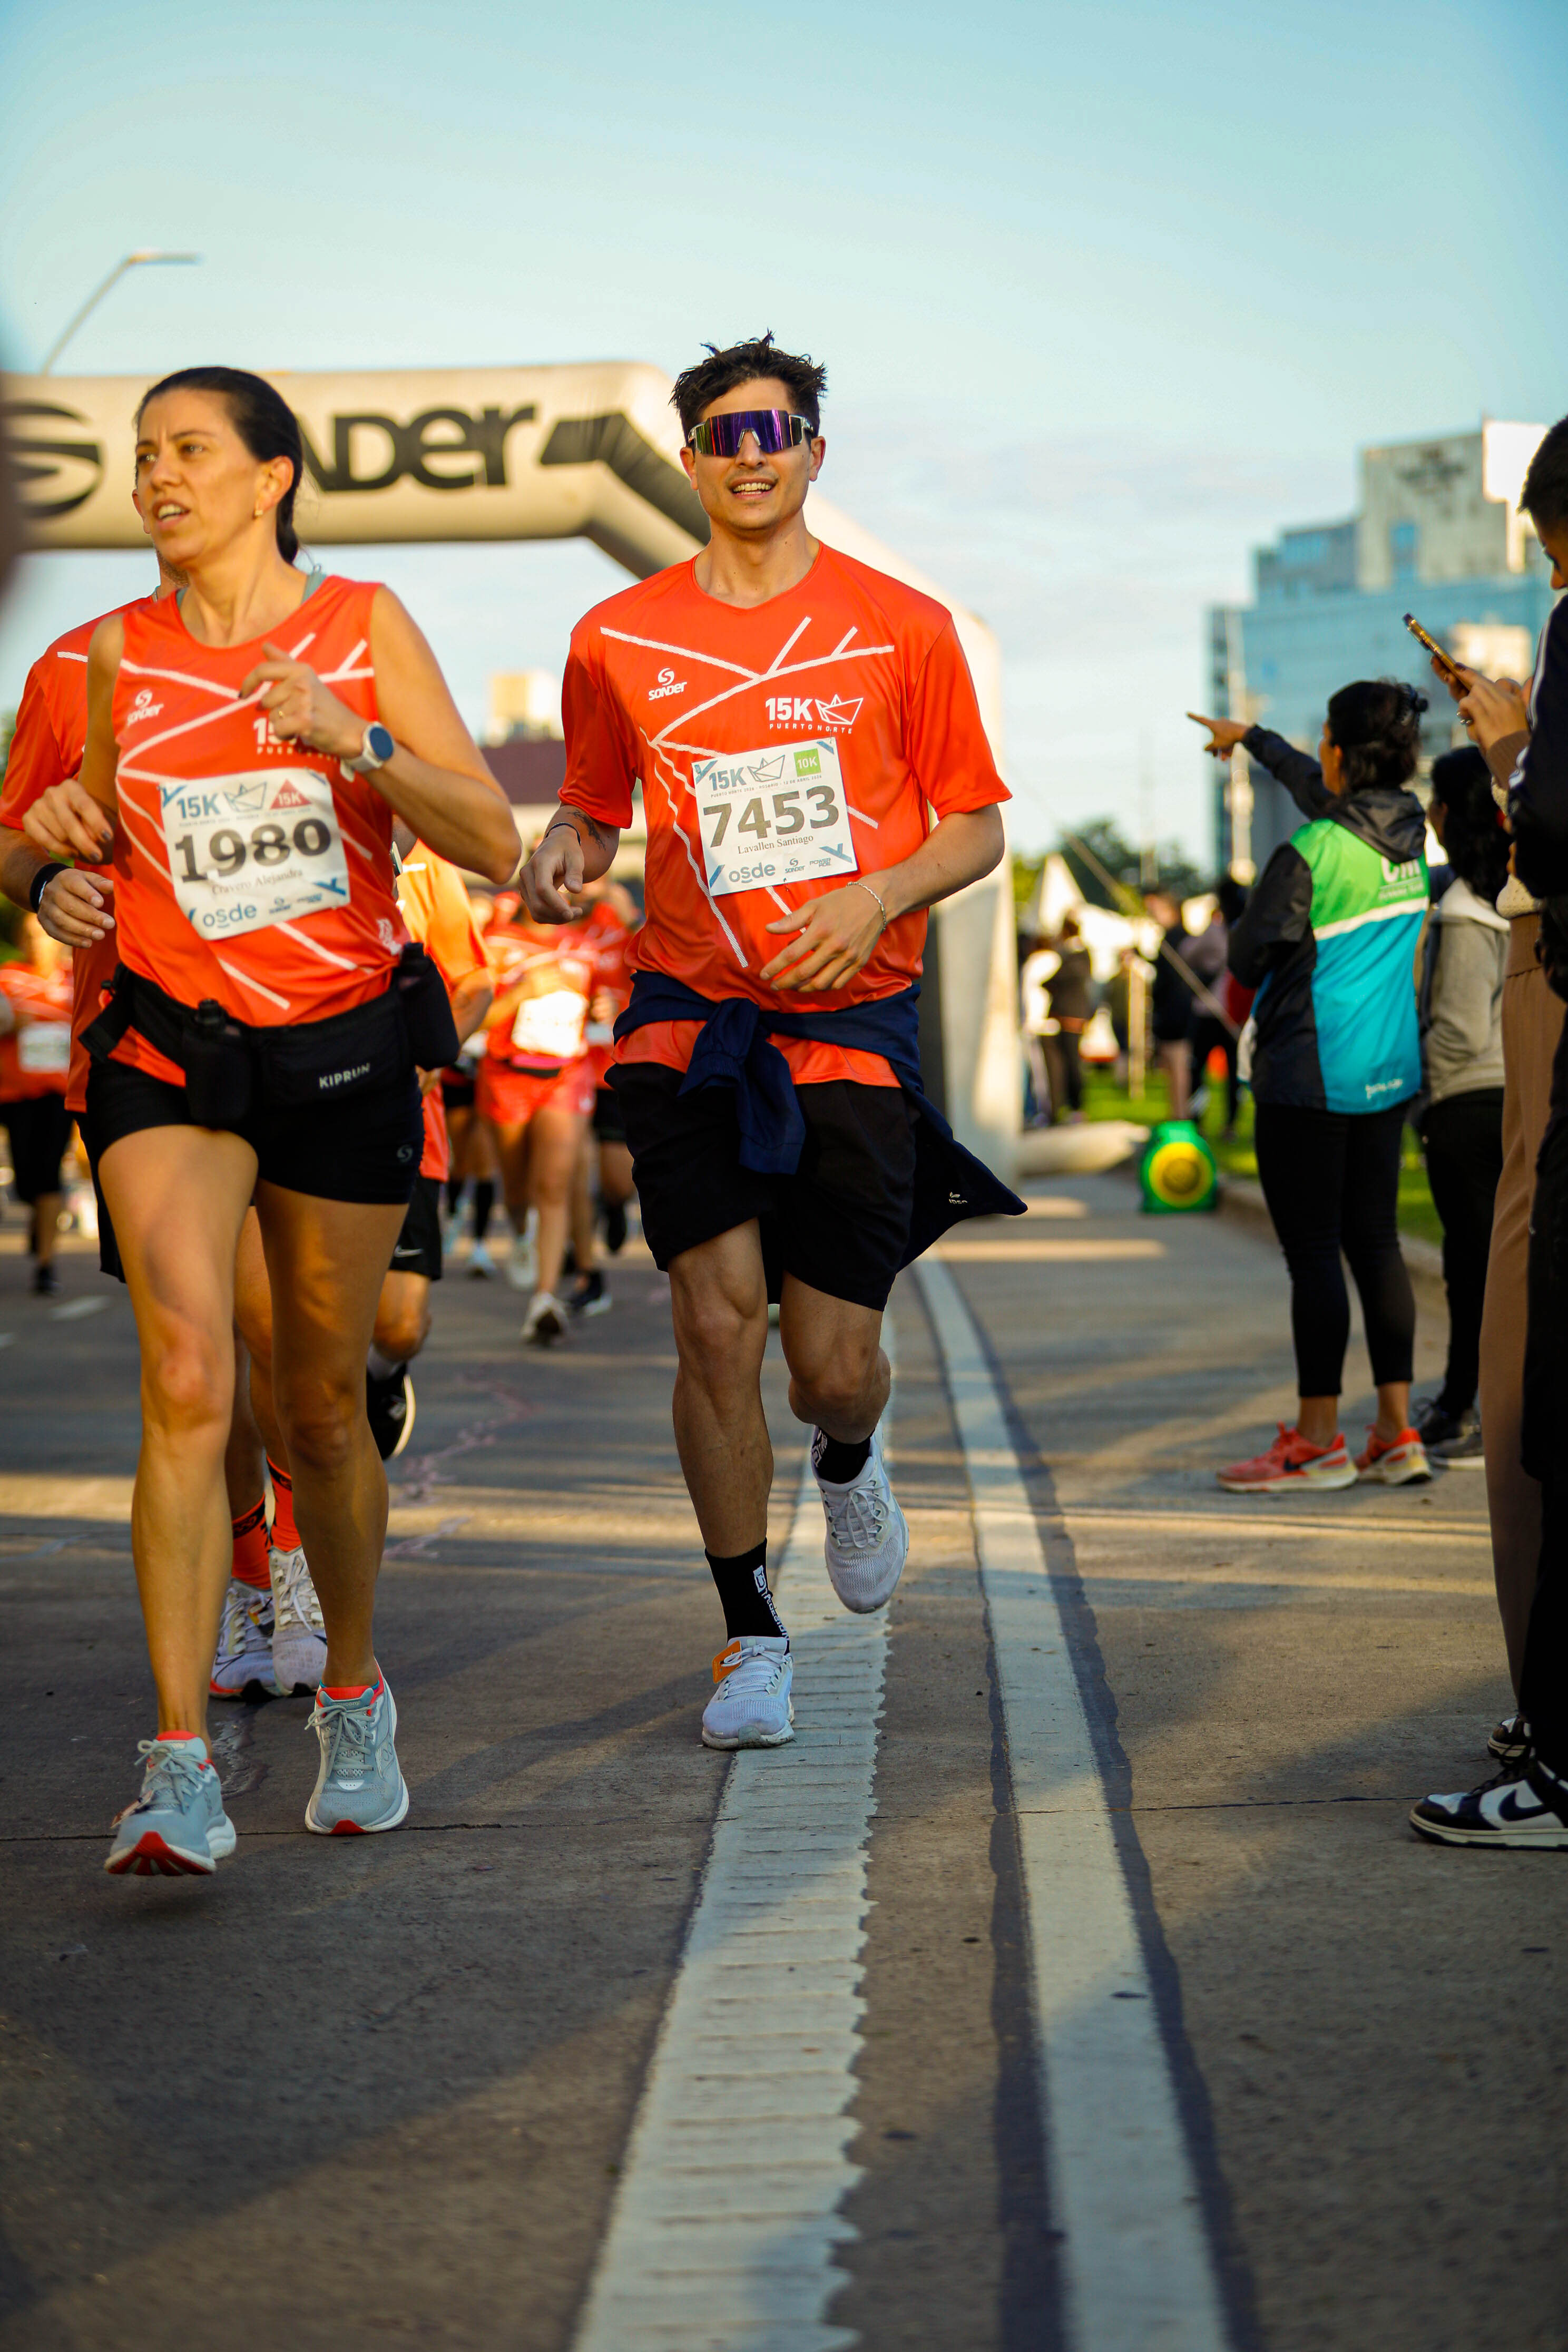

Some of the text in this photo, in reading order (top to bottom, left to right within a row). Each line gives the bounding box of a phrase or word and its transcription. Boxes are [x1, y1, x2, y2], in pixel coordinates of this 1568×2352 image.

[765, 697, 813, 721] 15K
[817, 725, 852, 734] NORTE
[709, 757, 818, 791] 15K 10K
[177, 792, 220, 819] 15K
[278, 791, 302, 807] 15K
[703, 785, 839, 848] 7453
[175, 818, 331, 884] 1980
[738, 835, 814, 855] Lavallen Santiago
[729, 862, 776, 884] osde
[809, 858, 831, 866] POWER
[203, 903, 257, 928] osde
[319, 1062, 370, 1090] KIPRUN
